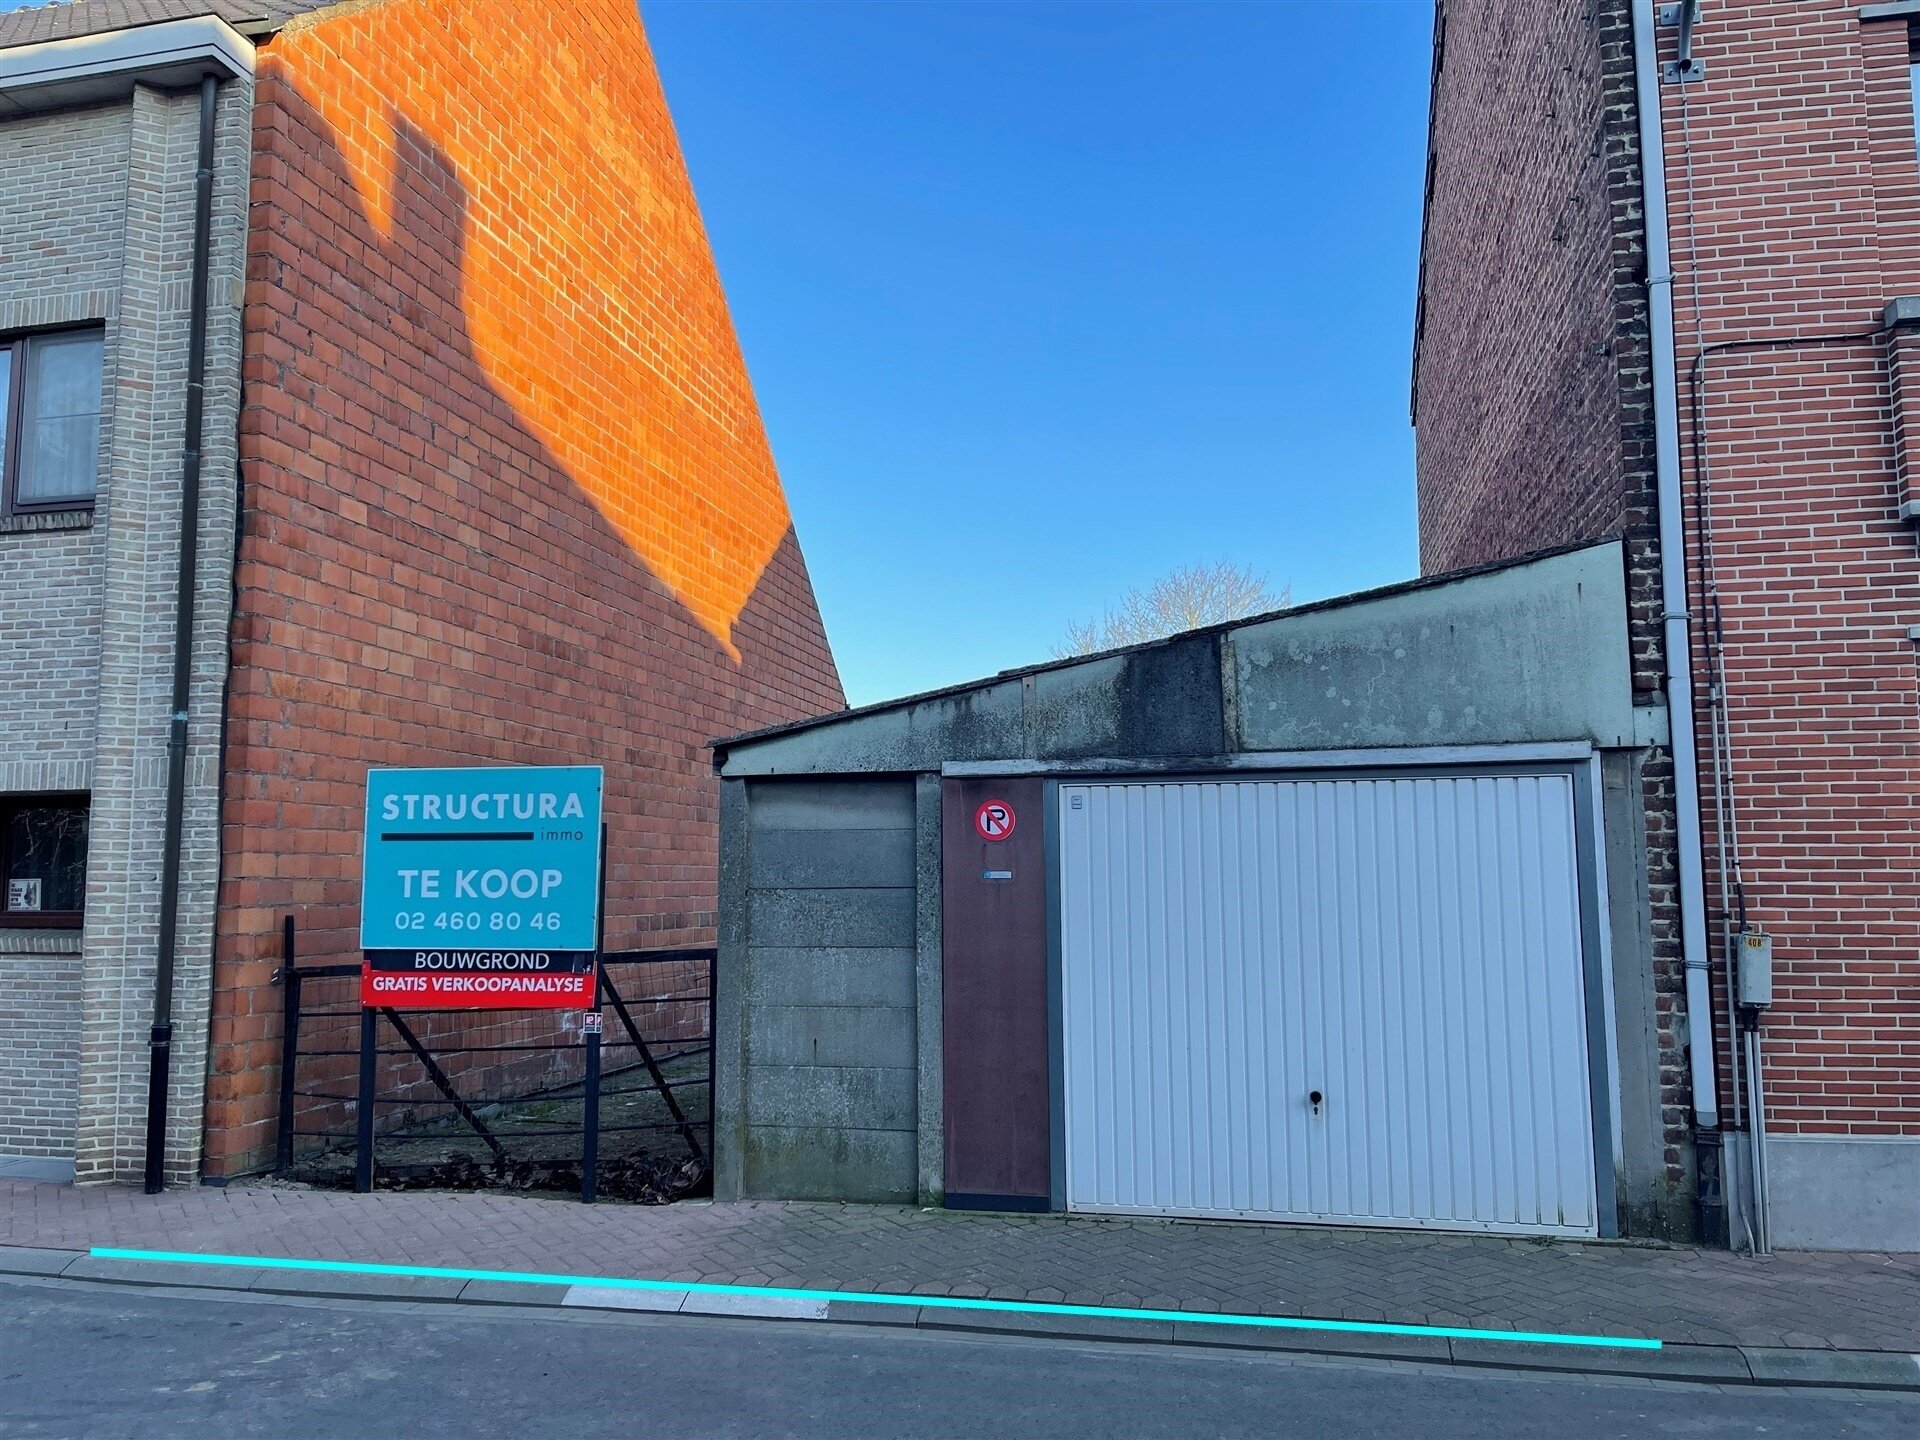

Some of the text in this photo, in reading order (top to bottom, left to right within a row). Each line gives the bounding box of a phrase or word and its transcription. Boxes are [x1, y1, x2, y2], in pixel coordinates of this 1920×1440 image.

[382, 793, 584, 820] STRUCTURA
[541, 828, 583, 841] immo
[398, 869, 562, 898] TE KOOP
[395, 912, 561, 931] 02 460 80 46
[414, 952, 550, 970] BOUWGROND
[372, 976, 584, 993] GRATIS VERKOOPANALYSE
